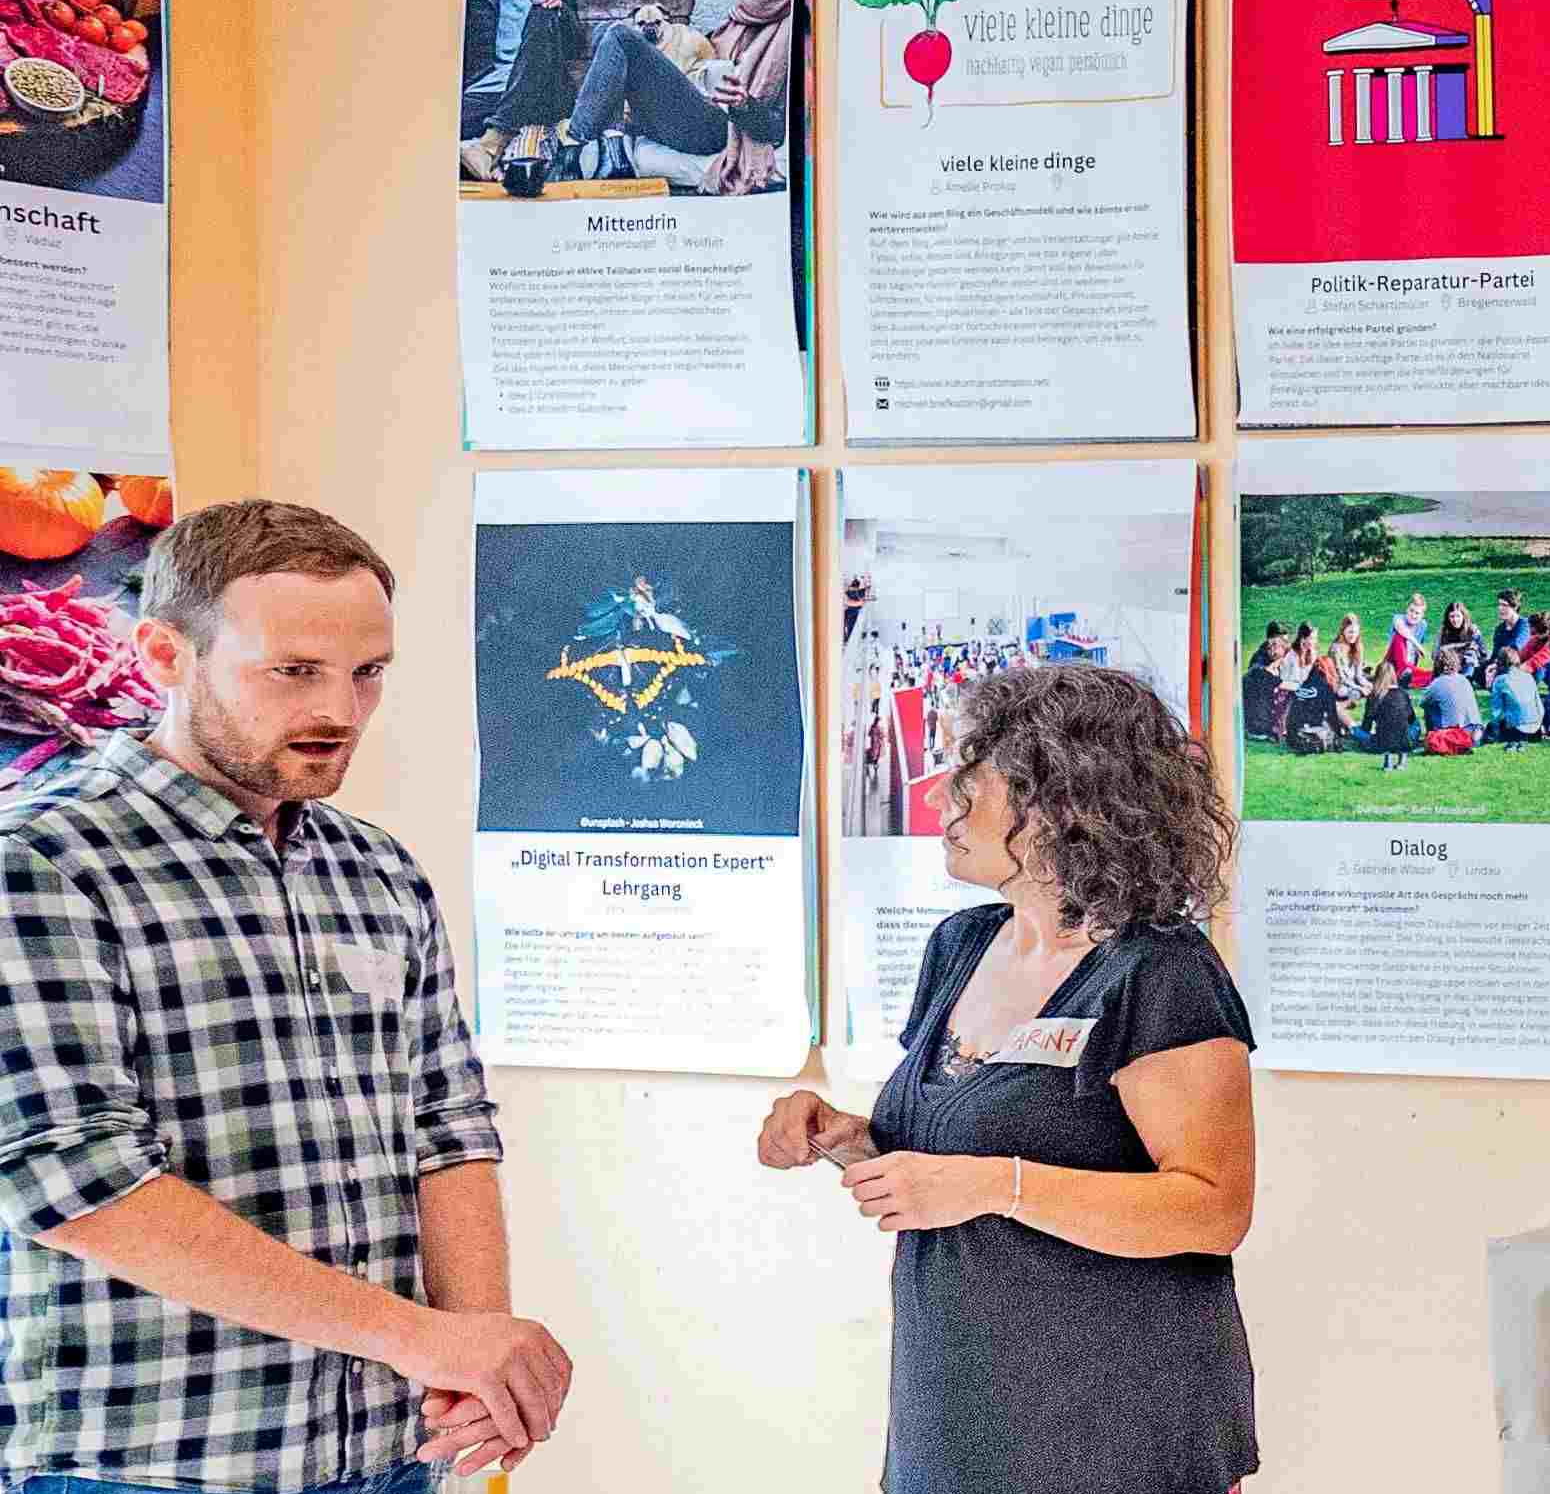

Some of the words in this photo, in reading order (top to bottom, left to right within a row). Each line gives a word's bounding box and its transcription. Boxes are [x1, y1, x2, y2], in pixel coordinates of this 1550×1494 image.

[963, 10, 1017, 43] viele
[1025, 6, 1091, 40] kleine
[1099, 4, 1153, 46] dinge
[940, 154, 984, 172] viele
[990, 154, 1039, 172] kleine
[1043, 151, 1096, 174] dinge
[587, 213, 677, 232] Mittendrin
[1311, 269, 1535, 296] Politik-Reparatur-Partei
[511, 850, 571, 871] „Digital
[575, 850, 708, 869] Transformation
[713, 852, 774, 872] Expert“
[1390, 839, 1448, 862] Dialog
[602, 879, 682, 902] Lehrgang
